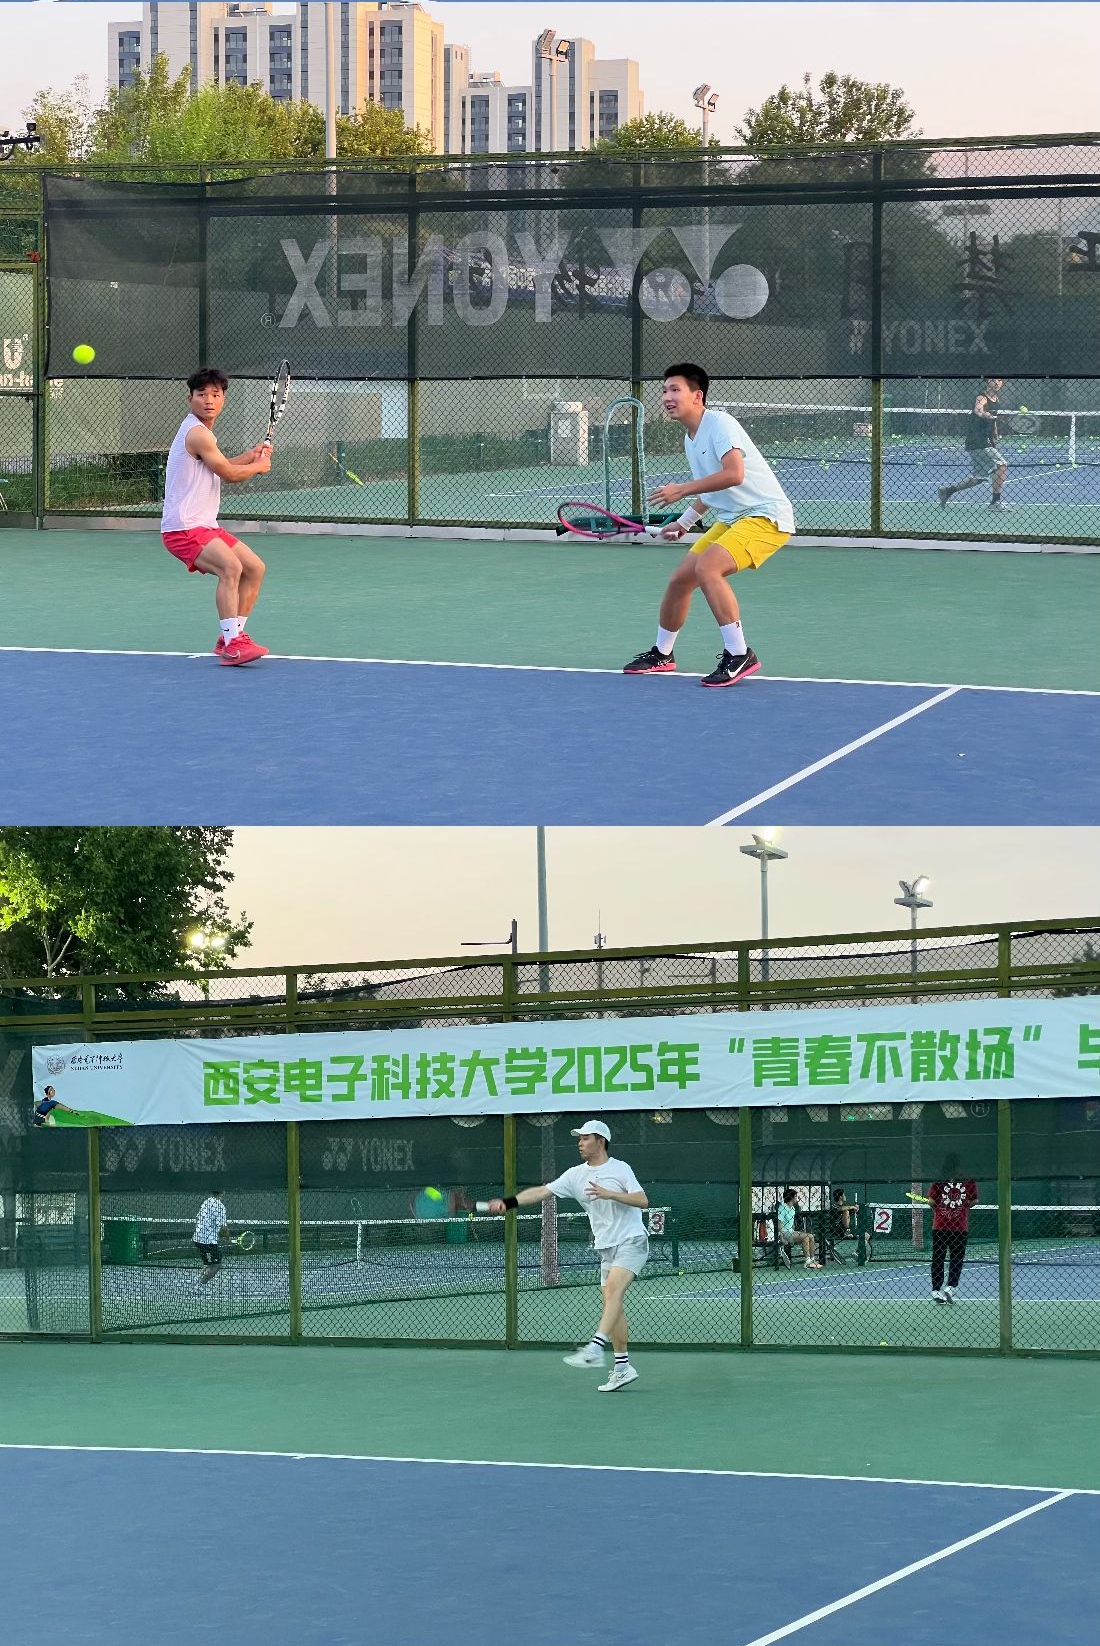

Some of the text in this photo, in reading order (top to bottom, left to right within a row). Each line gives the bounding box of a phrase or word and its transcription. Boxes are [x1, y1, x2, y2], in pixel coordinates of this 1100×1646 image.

[881, 319, 990, 355] YONEX
[154, 1136, 227, 1172] YONEX
[358, 1138, 415, 1171] YONEX
[651, 1213, 662, 1233] 3
[876, 1211, 890, 1231] 2
